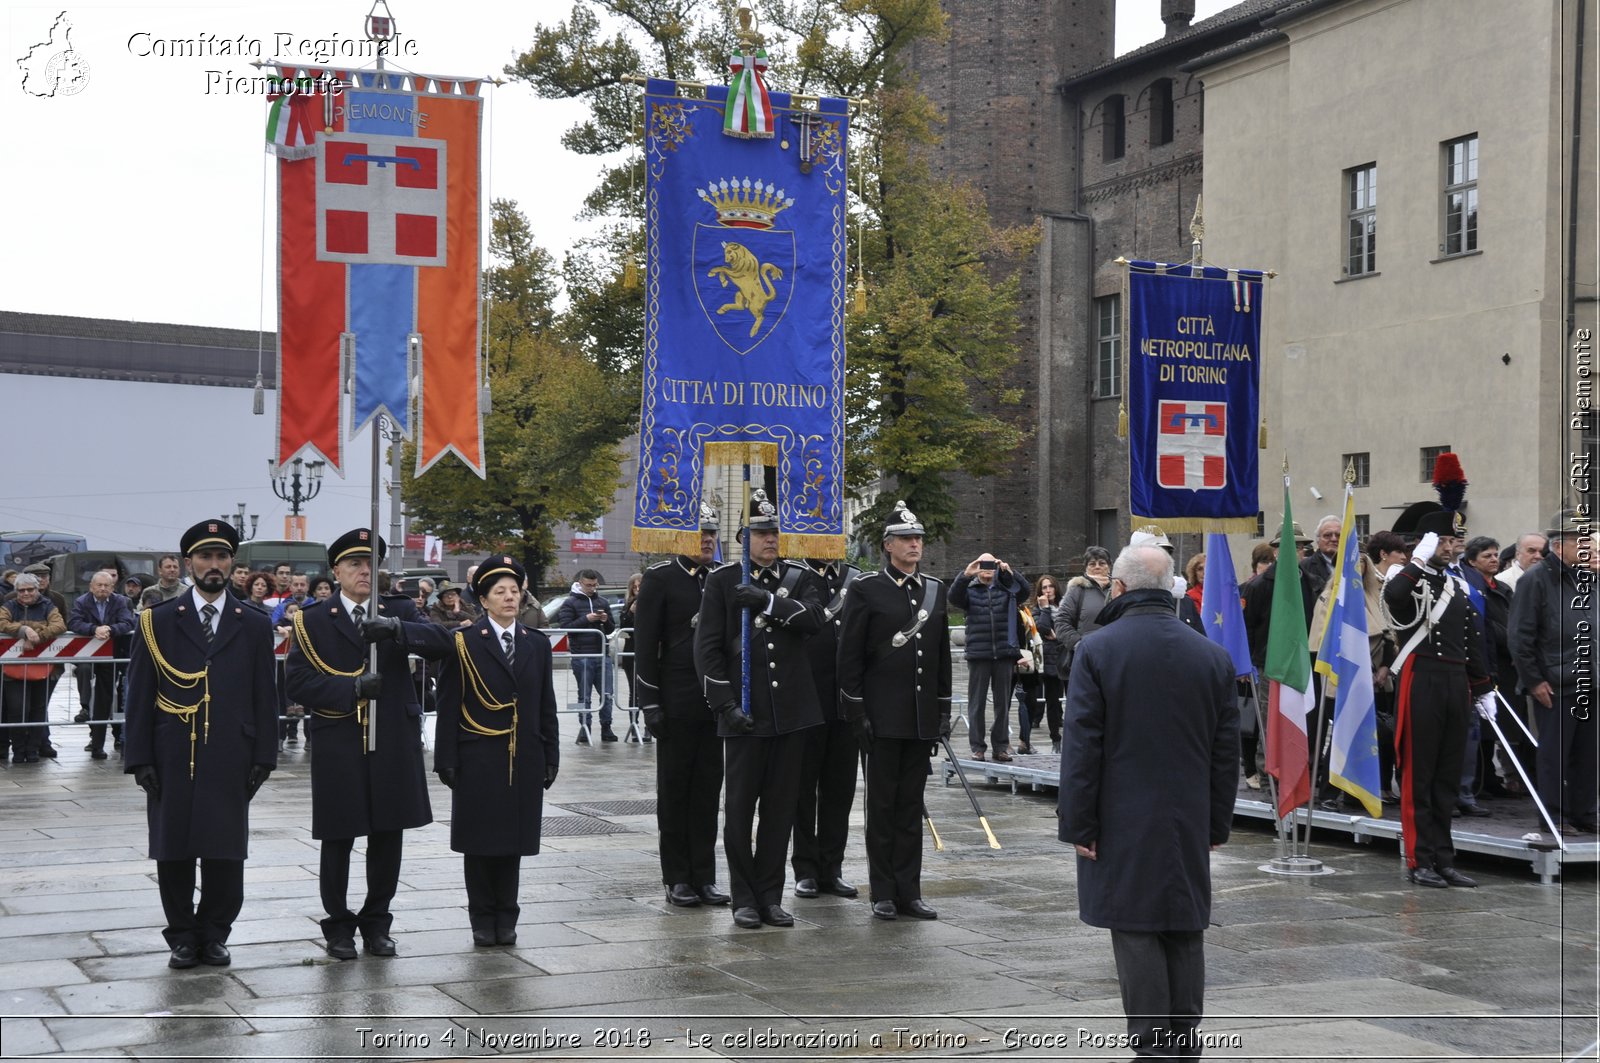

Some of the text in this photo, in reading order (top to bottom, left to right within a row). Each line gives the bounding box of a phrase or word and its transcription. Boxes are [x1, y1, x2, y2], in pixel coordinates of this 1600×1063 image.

[334, 103, 429, 129] PIEMONTE
[1177, 315, 1215, 336] CITTÀ
[1141, 337, 1251, 361] METROPOLITANA
[1160, 363, 1228, 385] DI TORINO
[662, 377, 826, 409] CITTA' DI TORINO
